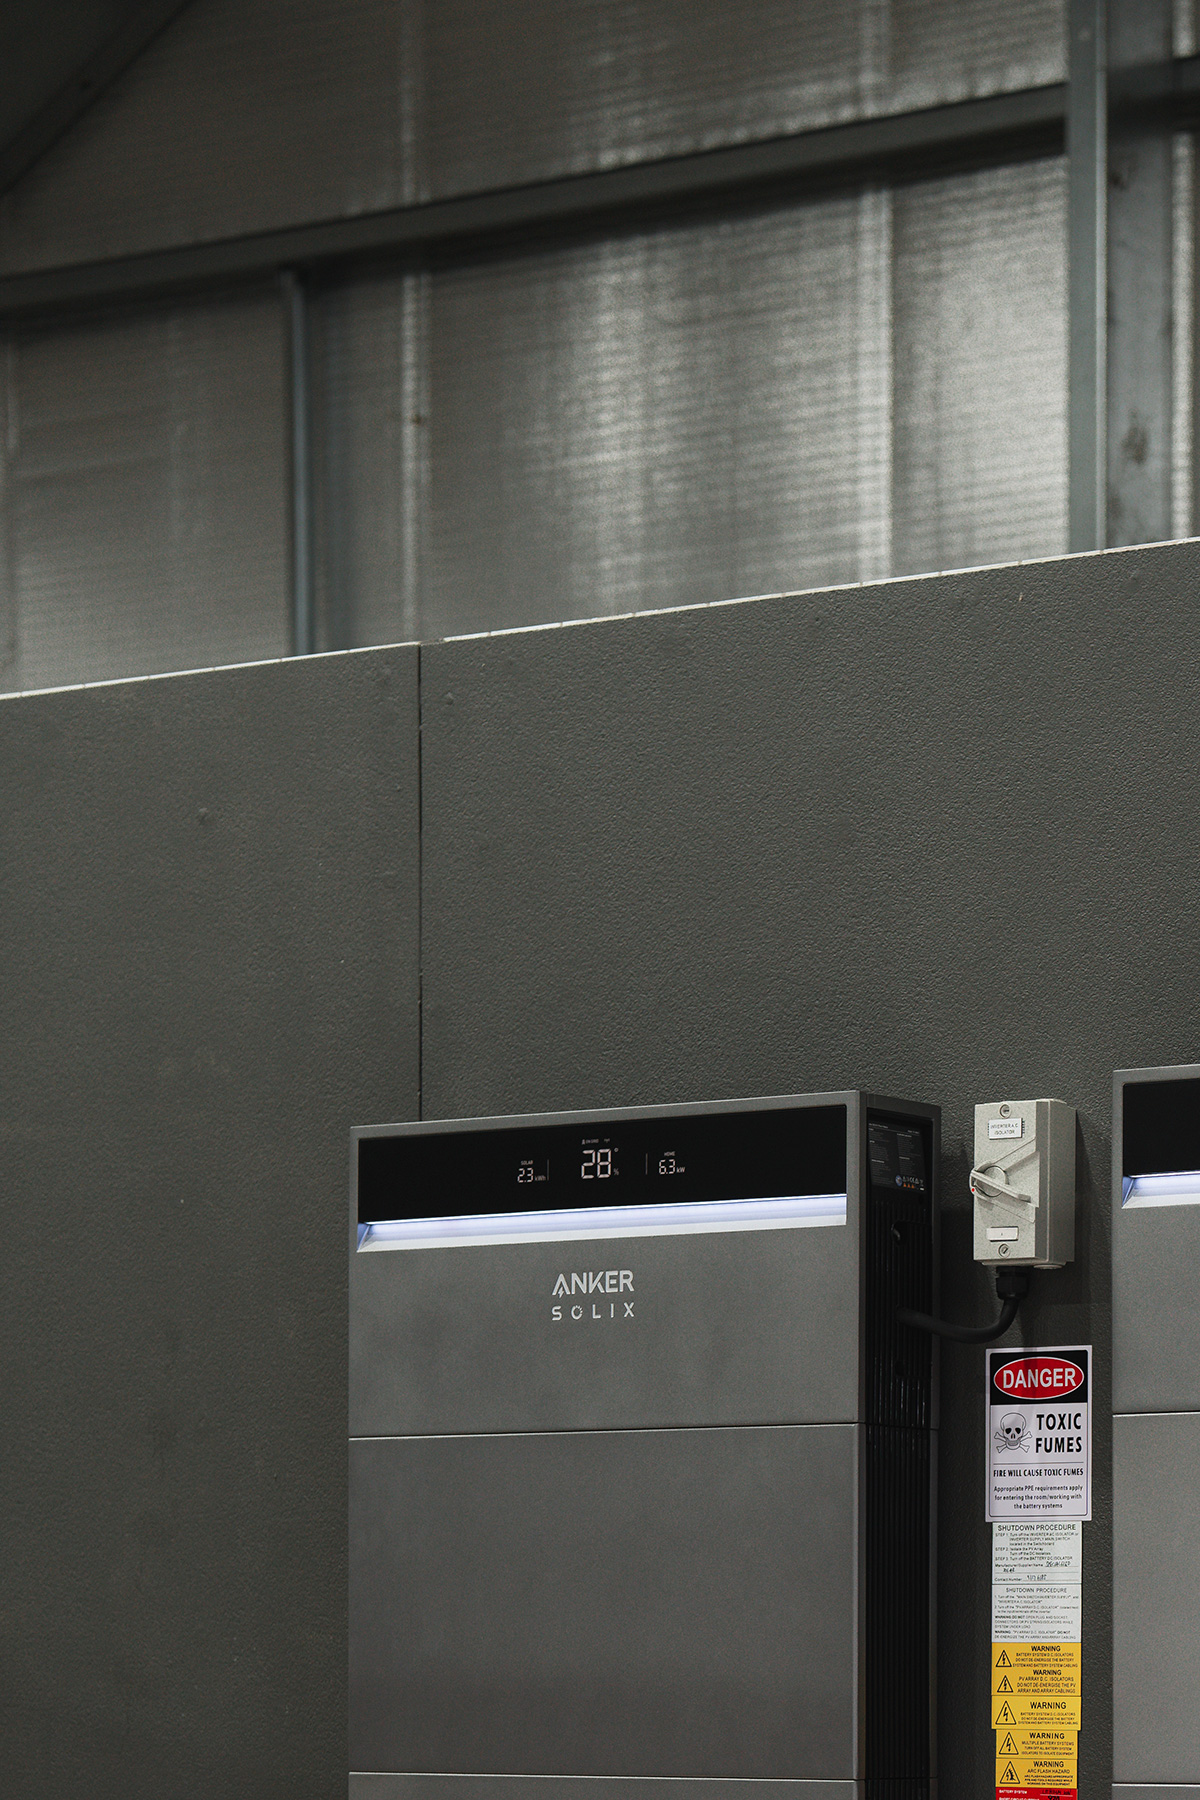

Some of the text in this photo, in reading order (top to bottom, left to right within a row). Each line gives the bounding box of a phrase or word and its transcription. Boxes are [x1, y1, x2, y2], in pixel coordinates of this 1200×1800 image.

[659, 1159, 676, 1175] 6.3
[517, 1168, 533, 1183] 2.3
[552, 1270, 634, 1298] ANKER
[552, 1302, 634, 1320] SOLIX
[1003, 1367, 1076, 1388] DANGER
[1036, 1413, 1081, 1430] TOXIC
[1036, 1437, 1082, 1453] FUMES
[1008, 1469, 1022, 1477] WILL
[1044, 1468, 1062, 1476] TOXIC
[1064, 1468, 1084, 1476] FUMES
